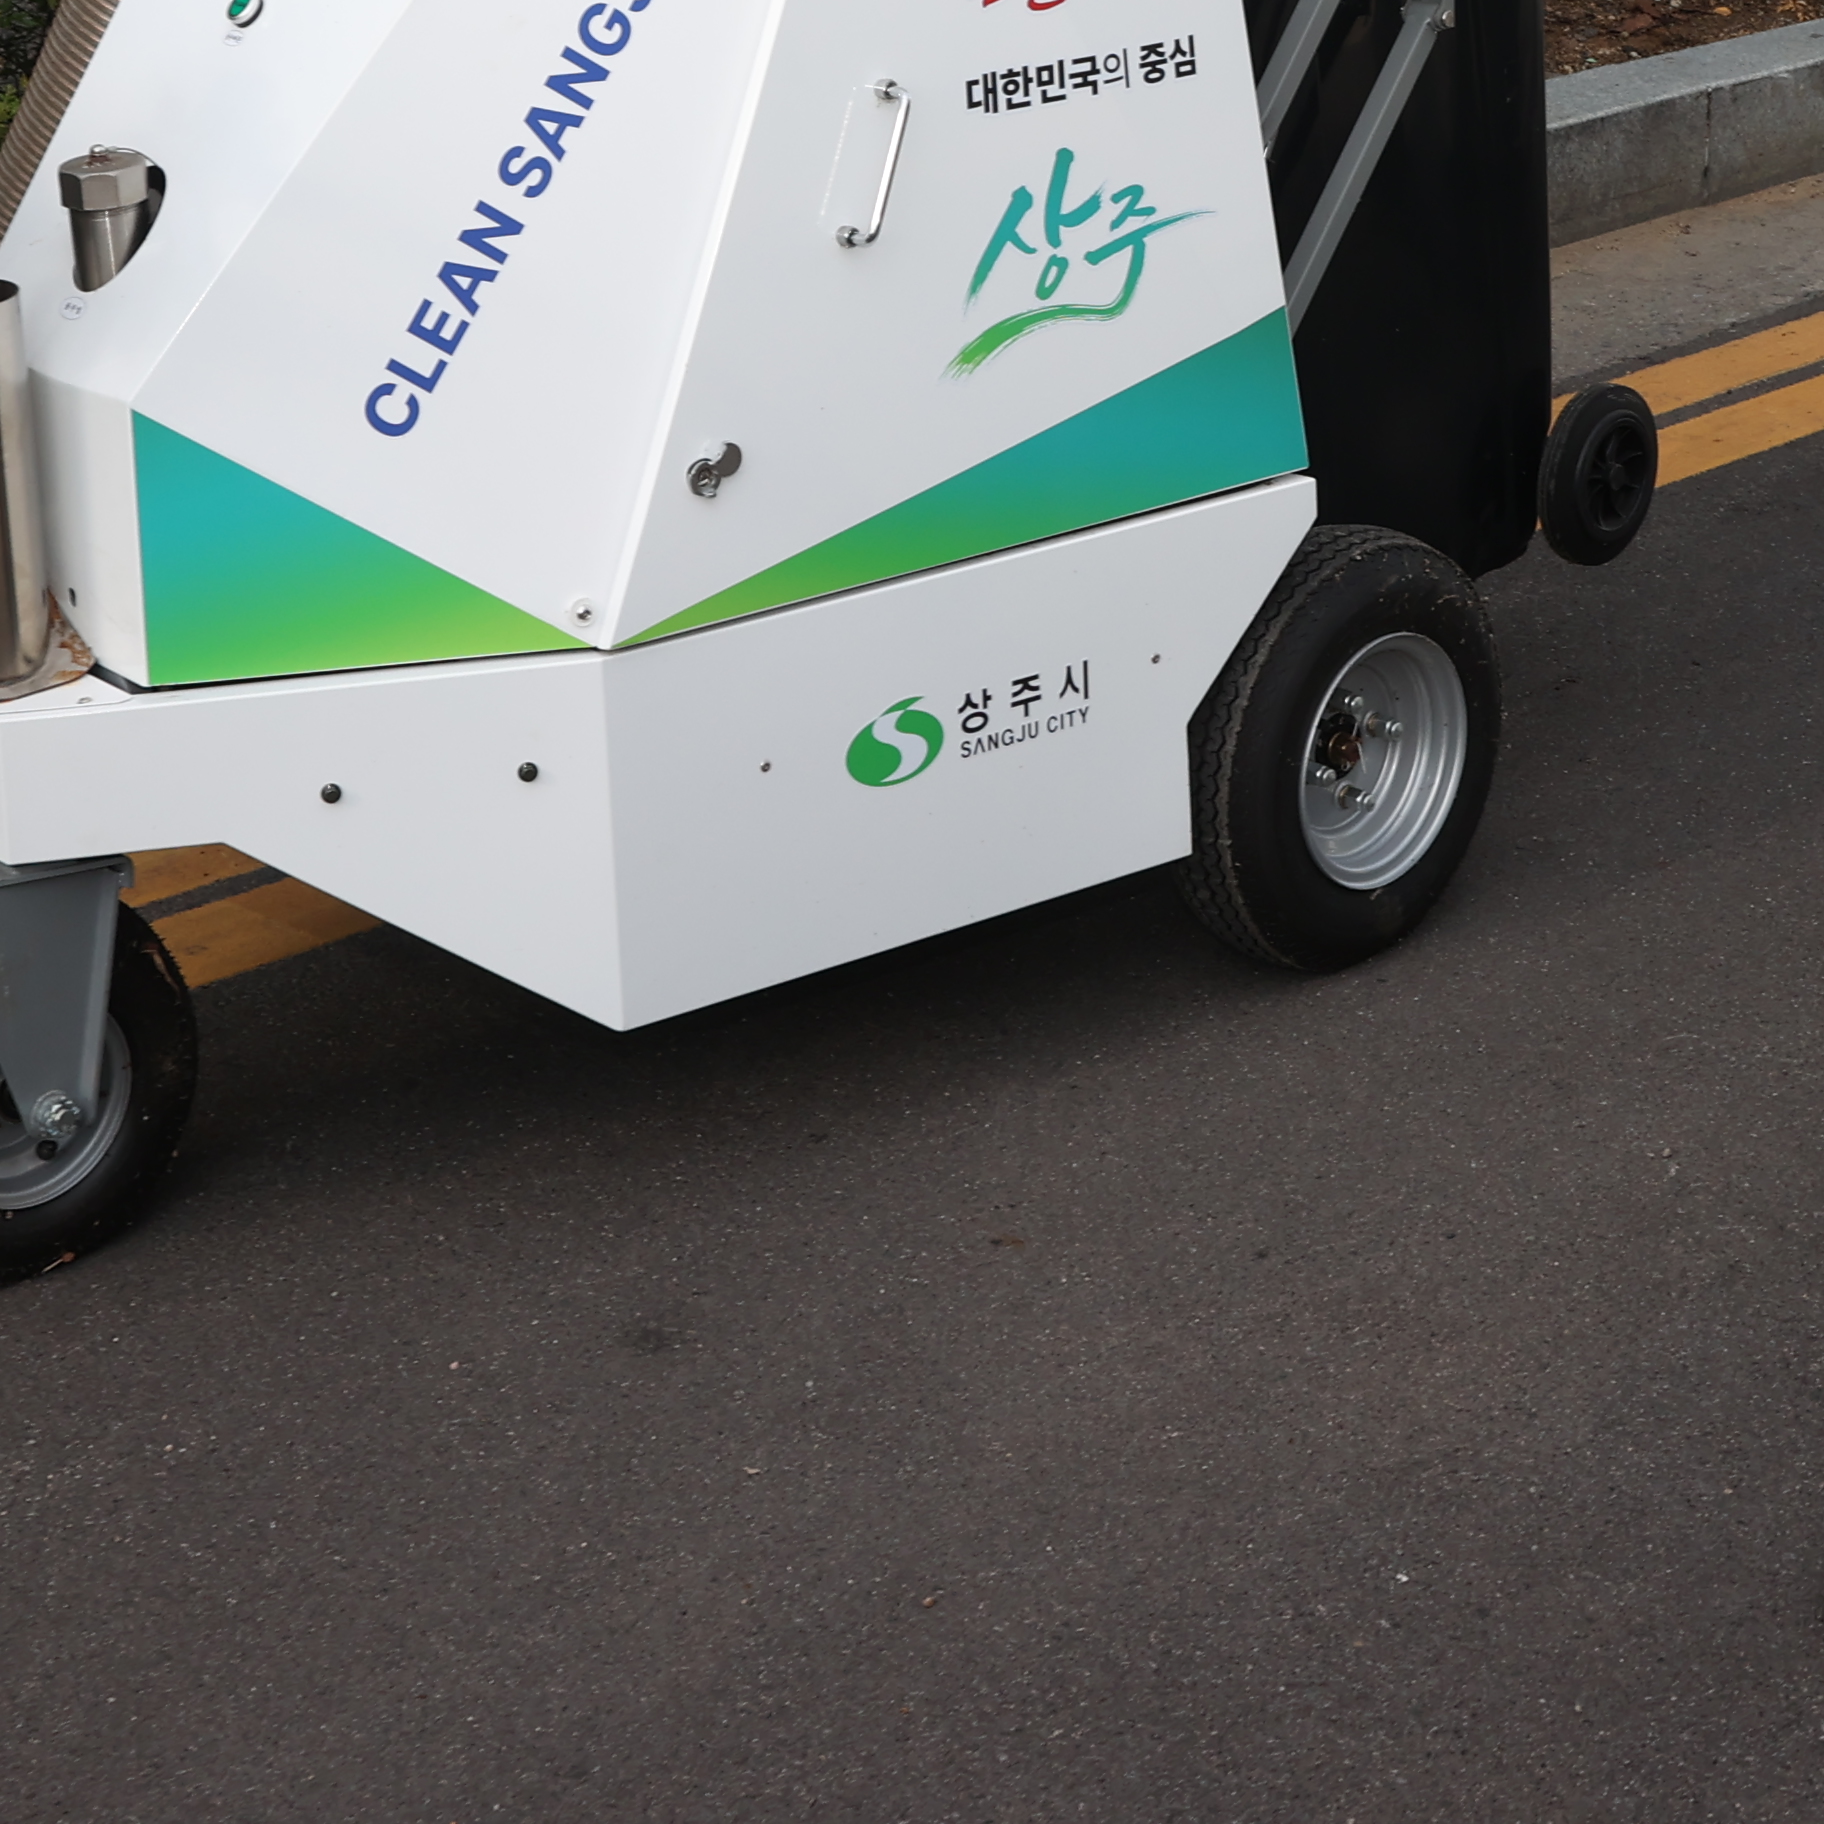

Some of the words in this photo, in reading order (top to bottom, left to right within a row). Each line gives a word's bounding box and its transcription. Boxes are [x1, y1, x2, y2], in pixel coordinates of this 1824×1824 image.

[964, 47, 1132, 116] 대한민국의
[1138, 34, 1198, 86] 중심
[942, 147, 1217, 366] 상주
[364, 198, 526, 438] CLEAN
[956, 658, 1092, 735] 상주시
[959, 717, 1040, 760] SANGJU
[1047, 704, 1092, 737] CITY
